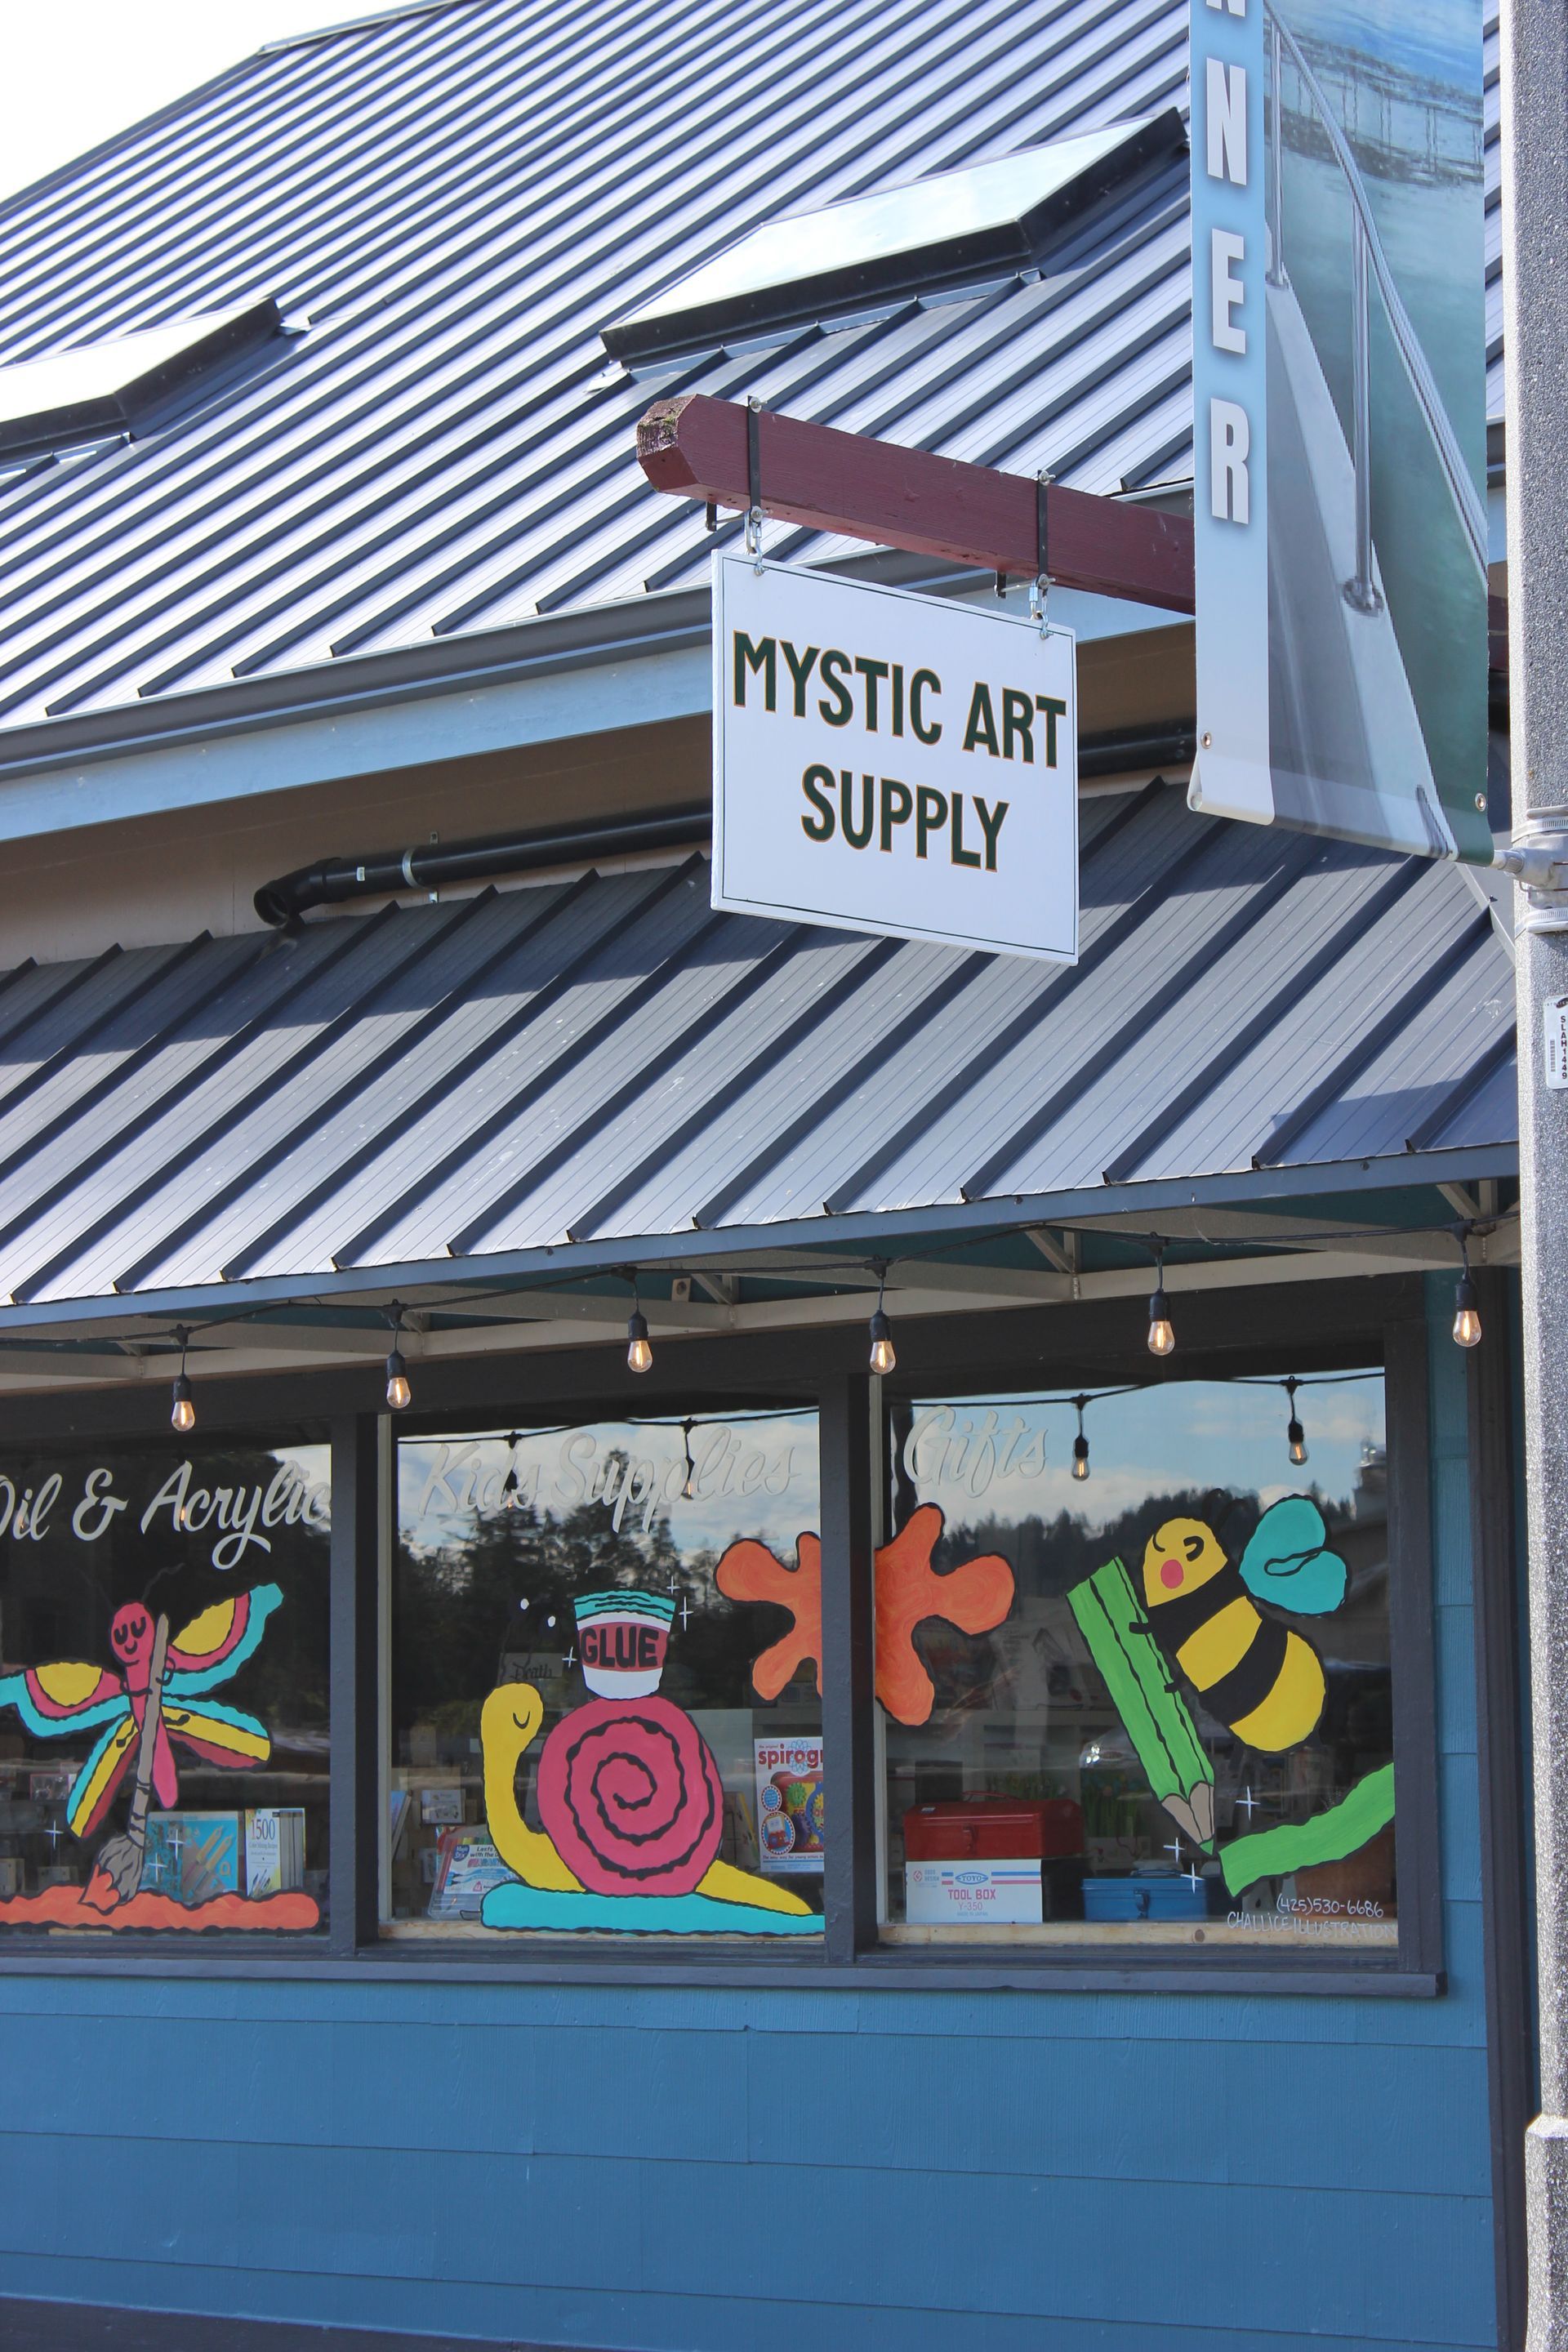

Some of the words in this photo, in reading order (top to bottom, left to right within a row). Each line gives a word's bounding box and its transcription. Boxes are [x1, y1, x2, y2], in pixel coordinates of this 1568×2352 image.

[1206, 0, 1250, 524] NER
[733, 630, 942, 746] MYSTIC
[962, 682, 1067, 768] ART
[801, 763, 1009, 872] SUPPLY
[418, 1442, 542, 1516] Kids
[550, 1425, 805, 1533] Supplies
[903, 1405, 1049, 1498] Gifts
[72, 1468, 129, 1541] &
[579, 1626, 660, 1668] GLUE
[251, 1818, 275, 1840] 1500
[948, 1889, 973, 1900] TOOL
[976, 1889, 996, 1900] BOX
[959, 1902, 983, 1911] Y-350
[1276, 1893, 1383, 1918] (425)530-6686
